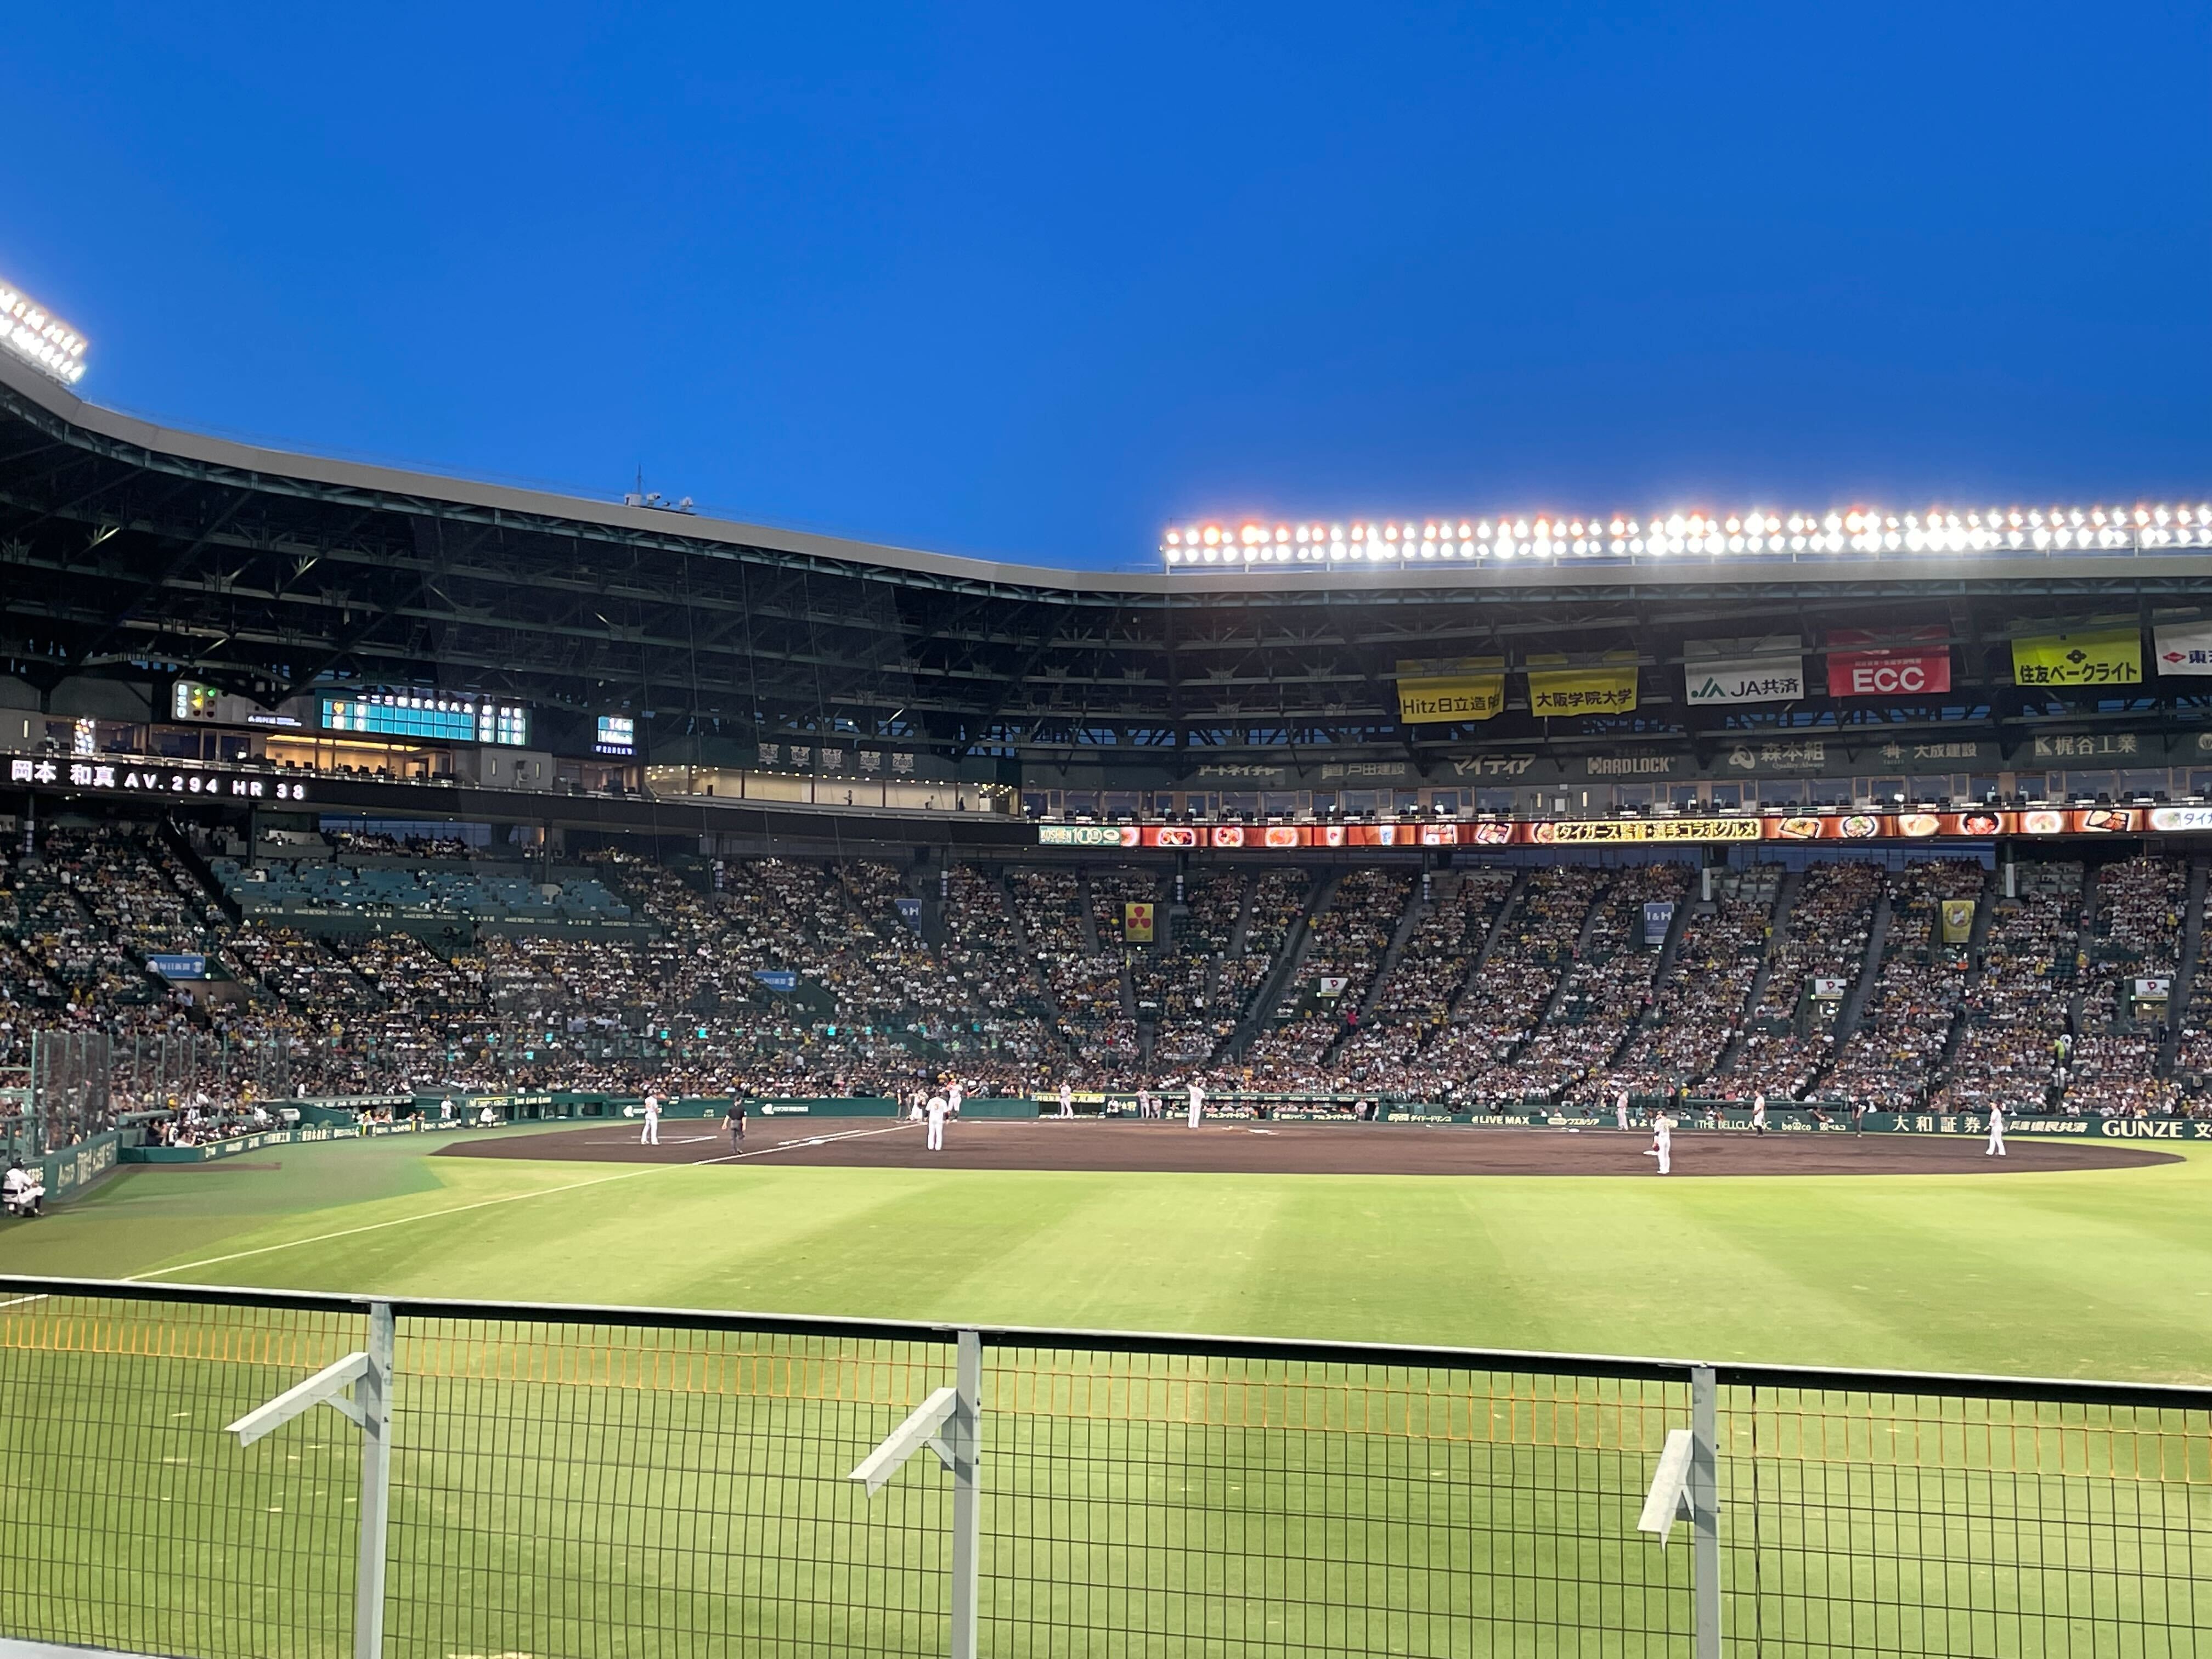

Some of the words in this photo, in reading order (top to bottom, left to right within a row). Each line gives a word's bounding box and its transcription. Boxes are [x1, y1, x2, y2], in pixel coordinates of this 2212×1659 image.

[2188, 649, 2212, 664] 東
[1853, 667, 1925, 692] ECC
[2019, 662, 2137, 684] 住友ベークライト
[1730, 678, 1799, 697] JA共済
[1536, 689, 1632, 707] 大阪学院大学
[1760, 741, 1825, 762] 森本組
[1914, 742, 1977, 759] 大成建設
[2054, 733, 2137, 755] 梶谷工業
[1347, 762, 1405, 776] 戸田建設
[1448, 753, 1536, 775] マイティア
[12, 759, 57, 784] 岡本
[70, 764, 115, 788] 和真
[172, 775, 217, 793] 294
[233, 780, 262, 797] HR
[276, 783, 304, 800] 38
[1647, 911, 1672, 921] I&H
[1479, 1115, 1503, 1124] LIVE
[1505, 1116, 1530, 1125] MAX
[1699, 1120, 1715, 1129] THE
[1892, 1115, 1980, 1132] 大和証券
[2102, 1120, 2183, 1138] GUNZE
[2194, 1121, 2212, 1138] 文
